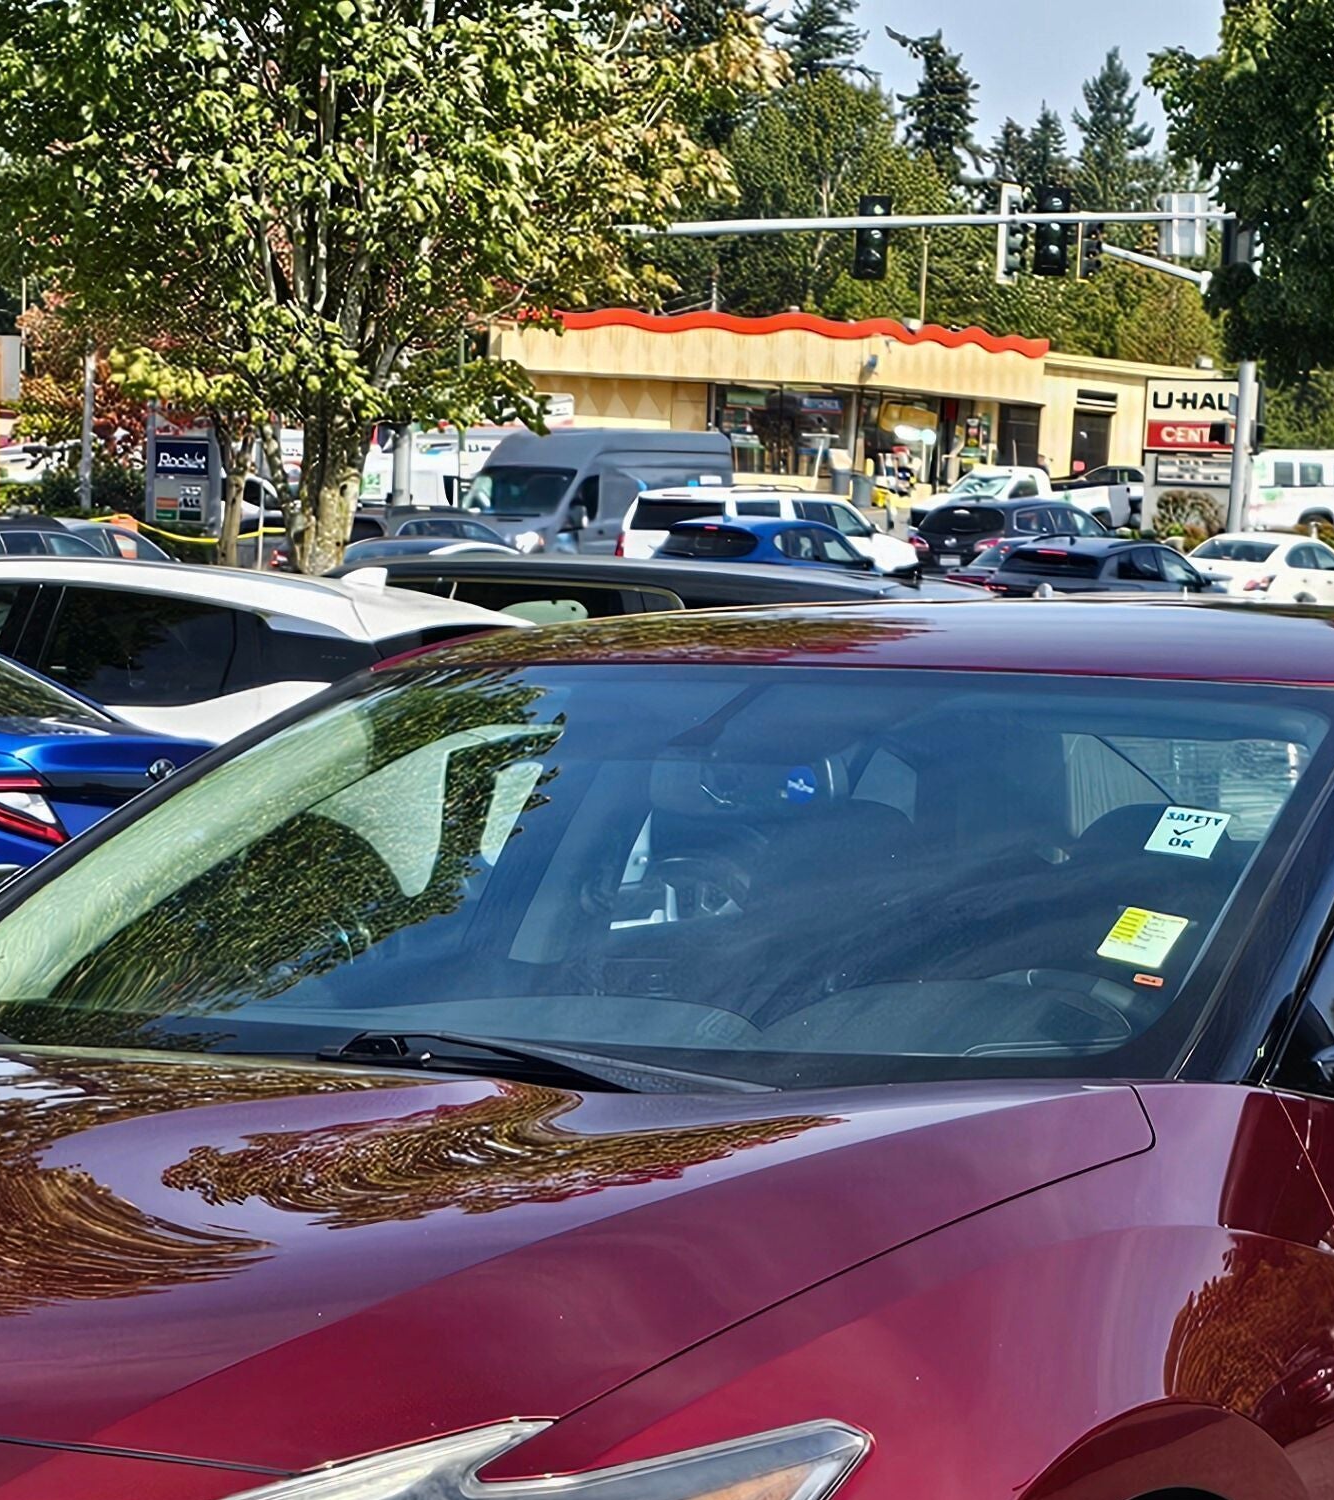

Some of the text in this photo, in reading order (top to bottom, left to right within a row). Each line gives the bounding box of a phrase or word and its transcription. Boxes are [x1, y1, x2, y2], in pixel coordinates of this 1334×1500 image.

[1153, 391, 1231, 411] U-HAU
[1167, 812, 1223, 826] SAFETY
[1168, 837, 1194, 848] OK
